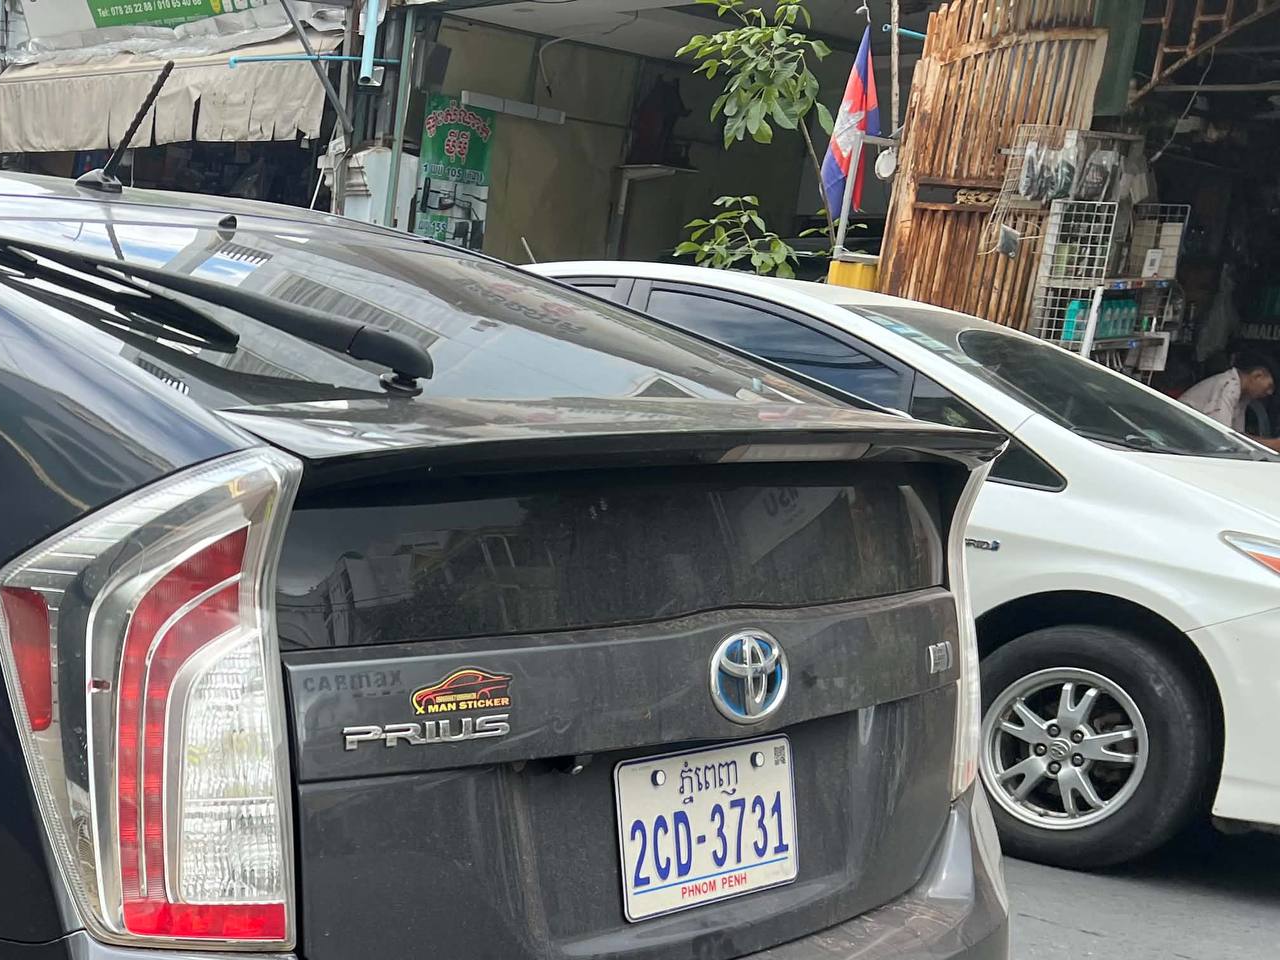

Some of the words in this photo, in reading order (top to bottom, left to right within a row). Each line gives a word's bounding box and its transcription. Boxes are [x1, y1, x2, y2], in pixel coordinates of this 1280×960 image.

[428, 703, 457, 713] MAN
[459, 697, 510, 710] STICKER
[342, 713, 511, 751] PRIUS
[679, 761, 738, 804] ភ្នំពេញ
[630, 791, 789, 888] 2CD-3731
[681, 881, 717, 899] PHNOM
[721, 873, 747, 890] PENH
